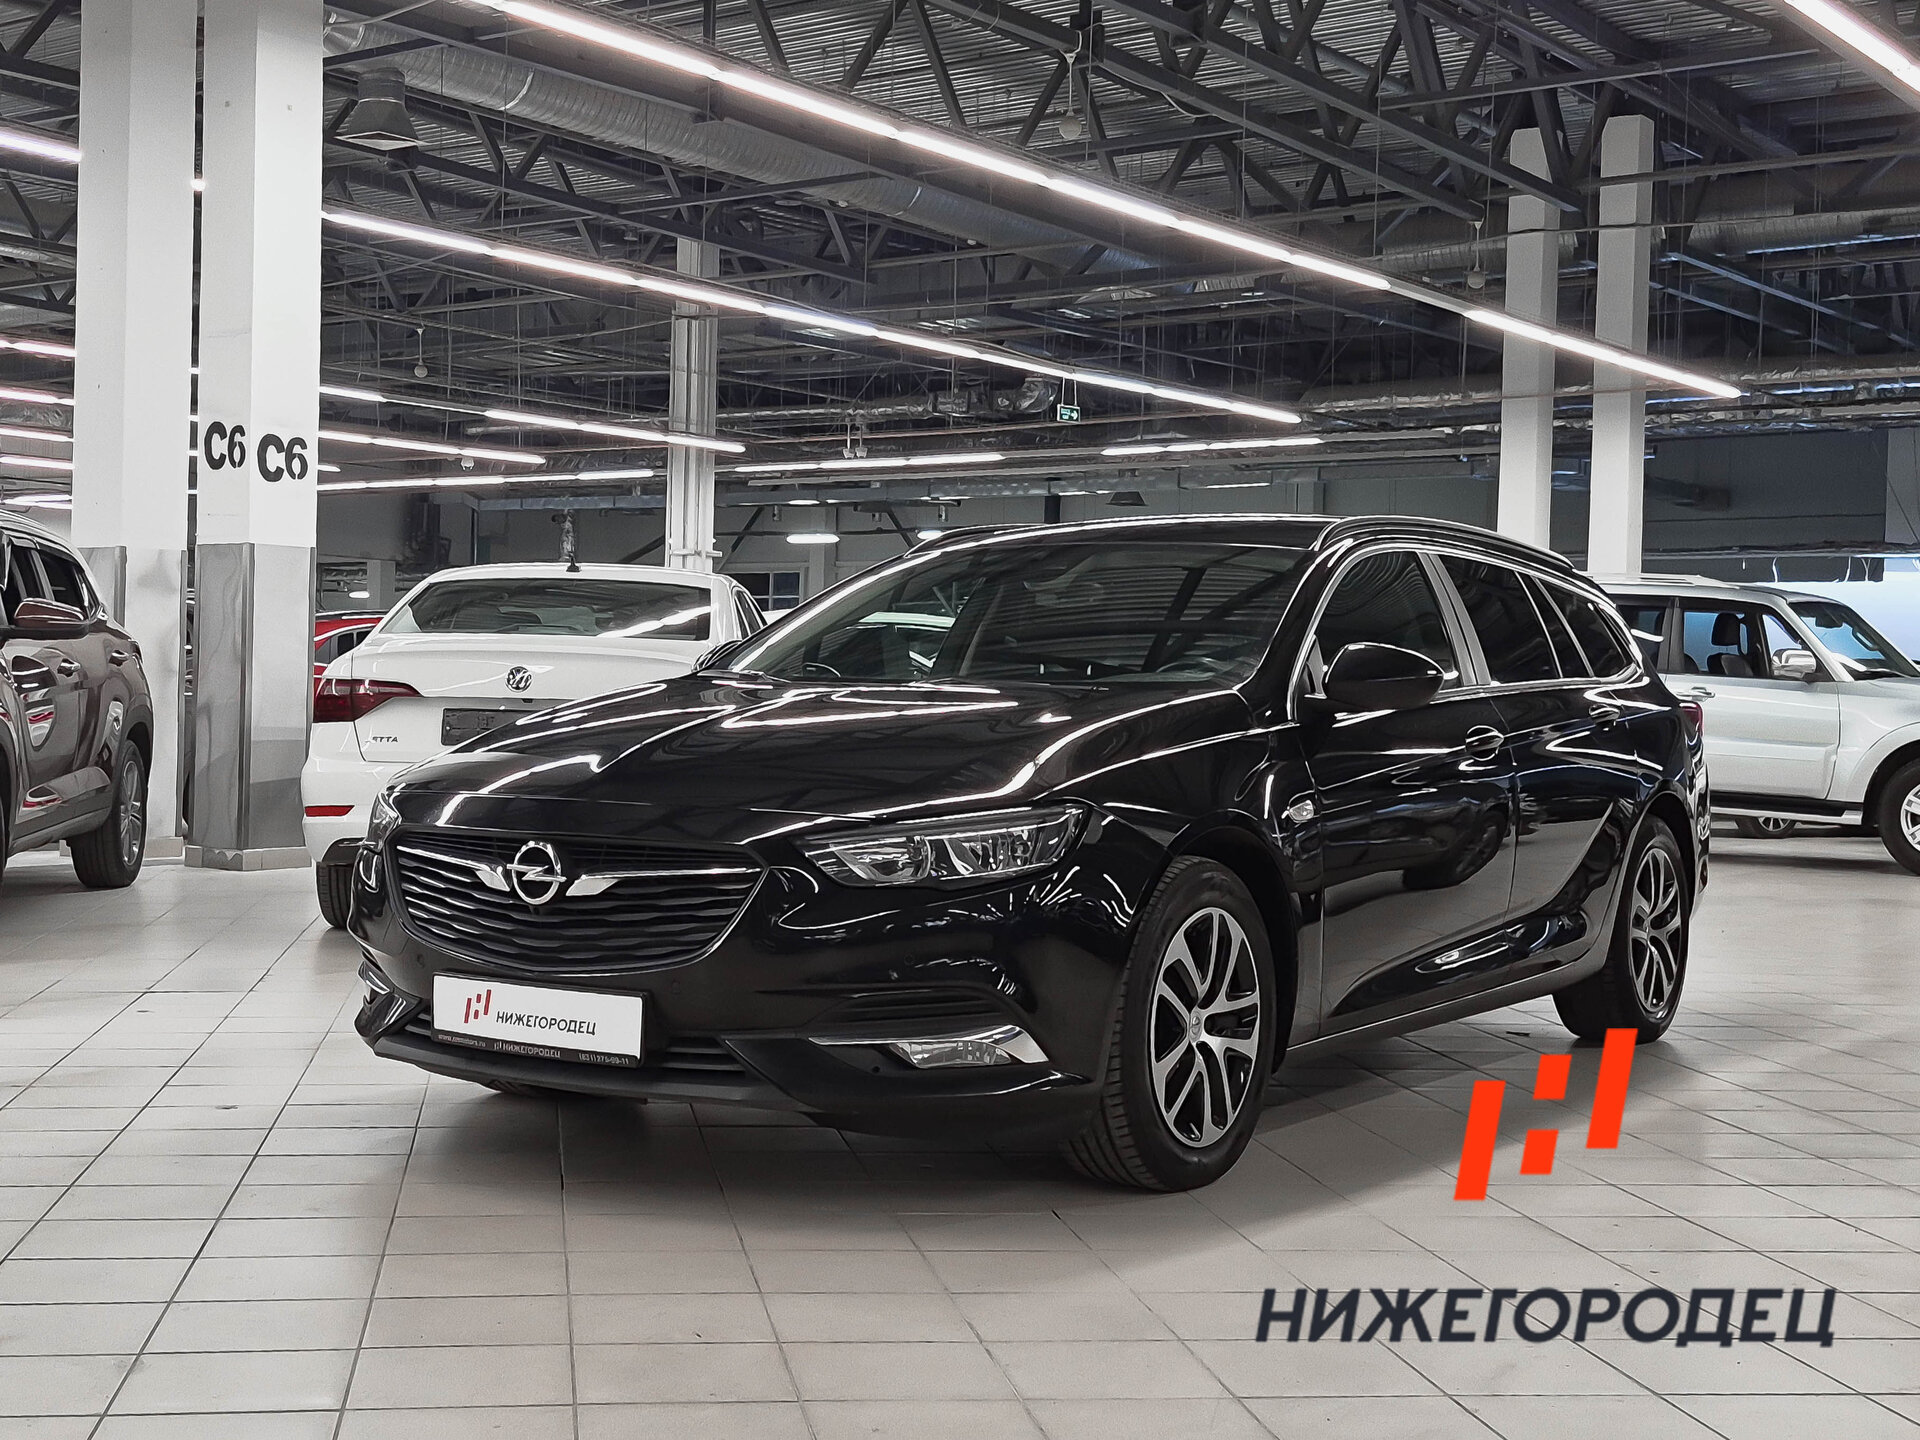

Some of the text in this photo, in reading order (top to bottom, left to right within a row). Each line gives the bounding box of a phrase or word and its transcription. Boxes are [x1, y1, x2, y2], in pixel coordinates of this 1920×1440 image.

[204, 421, 246, 470] C6
[257, 433, 308, 482] C6
[496, 1010, 597, 1035] НИЖЕГОРОДЕЦ
[502, 1042, 561, 1058] НИЖЕГОРОДЕЦ
